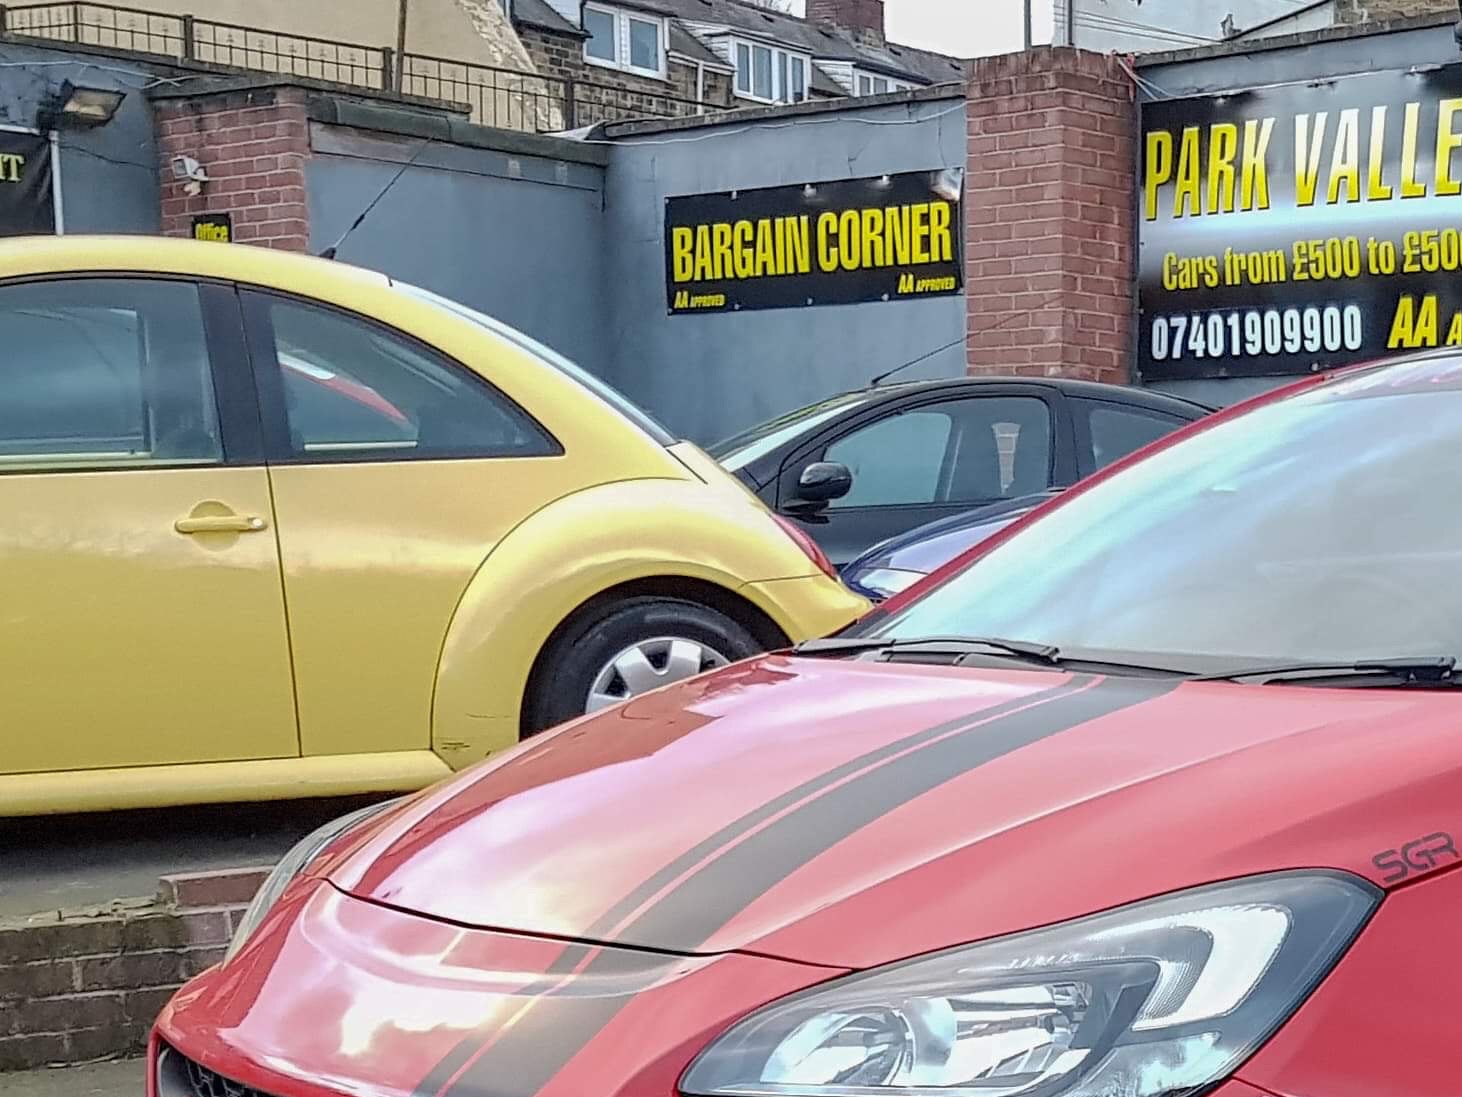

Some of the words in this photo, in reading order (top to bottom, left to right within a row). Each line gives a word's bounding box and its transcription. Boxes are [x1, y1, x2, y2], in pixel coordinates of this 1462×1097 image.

[1145, 117, 1276, 221] PARK
[672, 215, 811, 282] BARGAIN
[818, 201, 952, 272] CORNER
[1163, 251, 1218, 291] Cars
[1224, 247, 1287, 286] from
[1292, 236, 1361, 281] £500
[1367, 236, 1396, 276] to
[674, 291, 688, 309] AA
[898, 273, 914, 294] AA
[915, 276, 955, 292] APPROVED
[1151, 304, 1363, 361] 07401909900
[1386, 295, 1438, 349] AA
[1371, 831, 1460, 883] SGR
